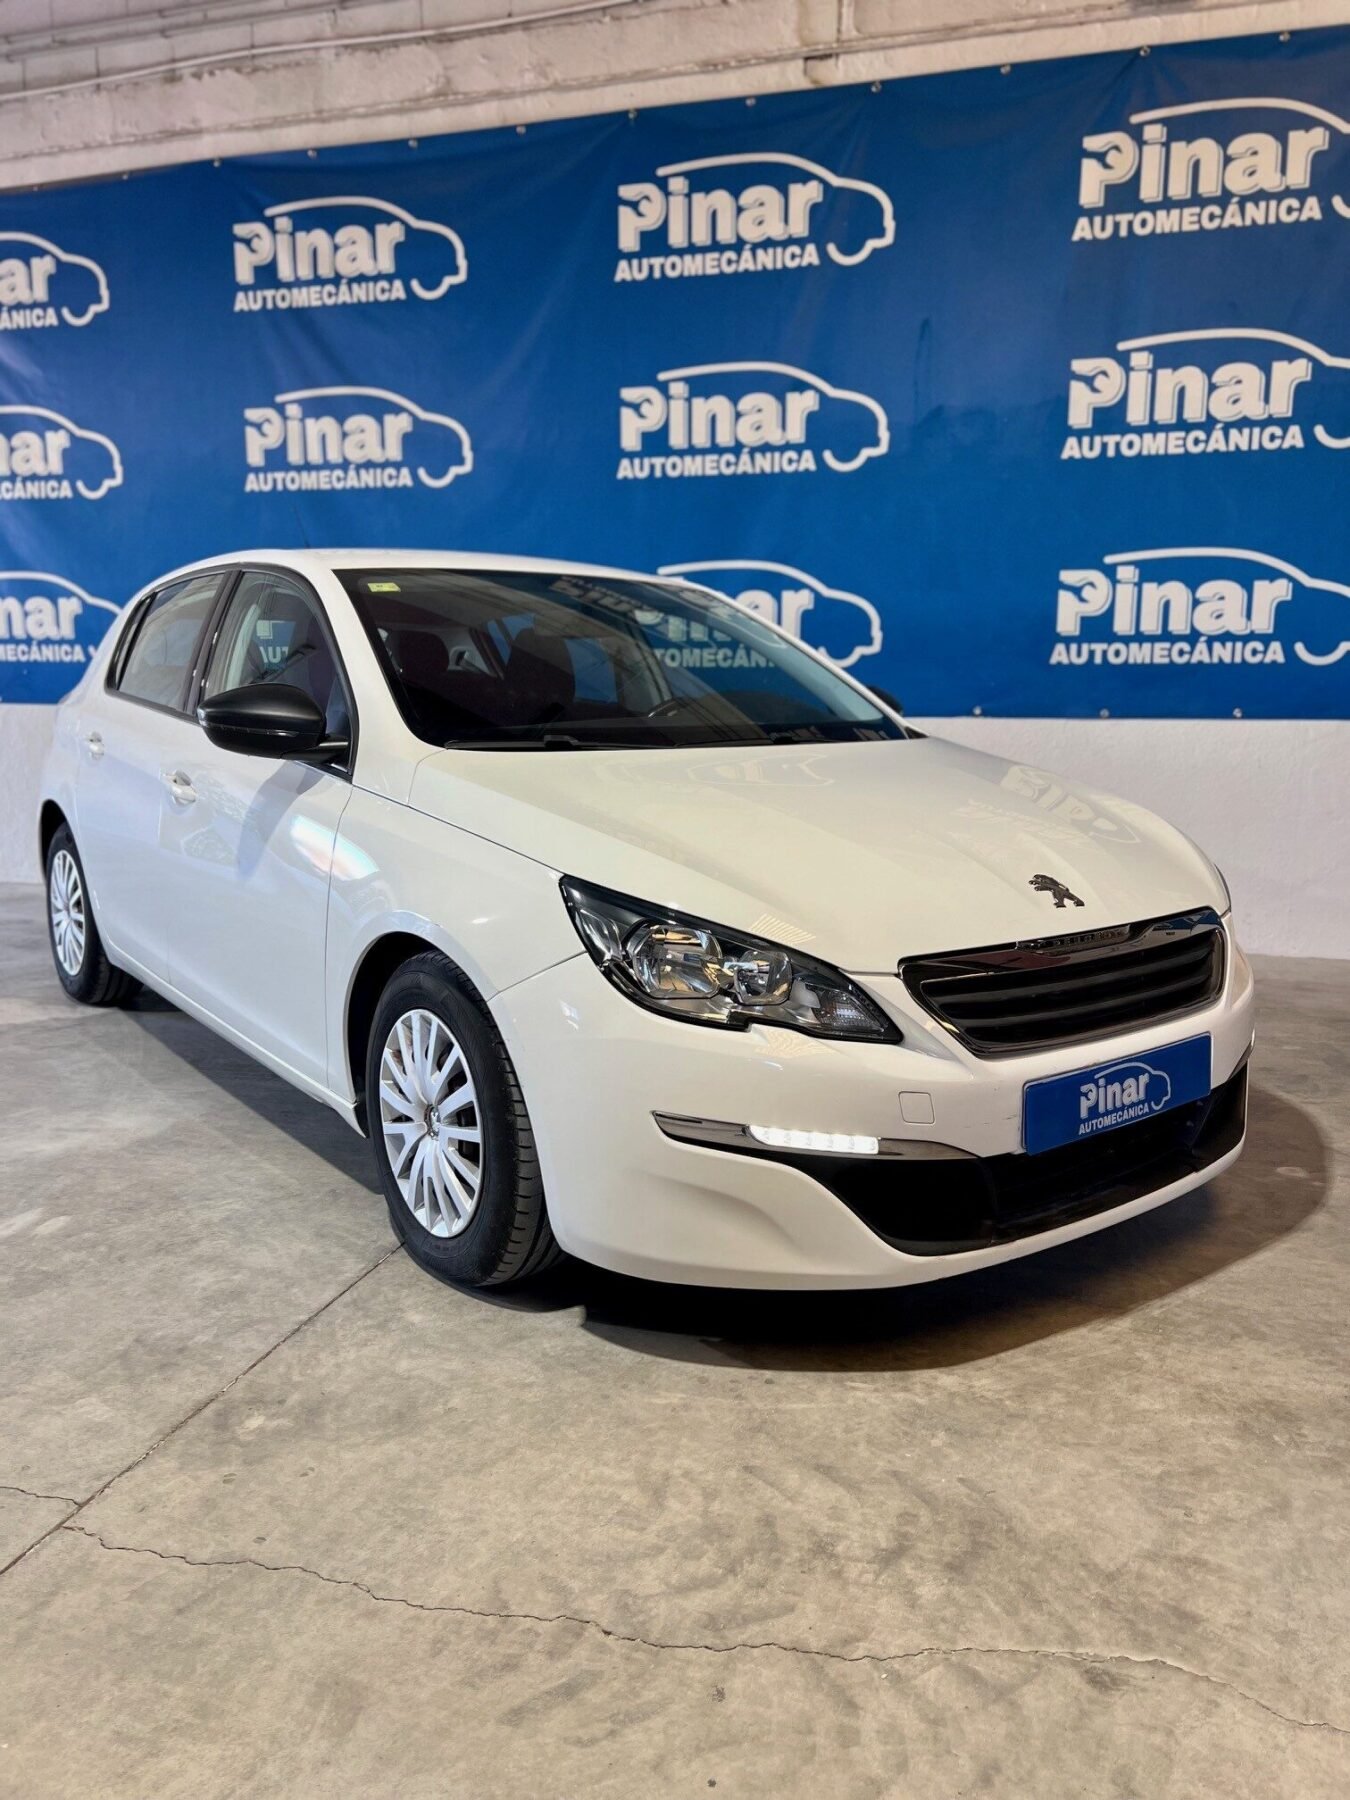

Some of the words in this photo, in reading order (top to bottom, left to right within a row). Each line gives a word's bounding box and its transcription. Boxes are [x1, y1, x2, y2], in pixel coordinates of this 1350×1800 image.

[1078, 123, 1330, 209] Pinar
[618, 176, 824, 253] Pinar
[1071, 196, 1323, 242] AUTOMECÁNICA
[233, 215, 406, 286] Pinar
[614, 243, 820, 283] AUTOMECÁNICA
[233, 279, 407, 313] AUTOMECÁNICA
[1067, 351, 1312, 429] Pinar
[244, 403, 413, 468] Pinar
[620, 380, 820, 452] Pinar
[616, 447, 817, 480] AUTOMECÁNICA
[1061, 423, 1304, 460] AUTOMECÁNICA
[244, 464, 413, 493] AUTOMECÁNICA
[1056, 565, 1293, 636] Pinar
[1049, 636, 1286, 665] AUTOMECÁNICA
[1078, 1102, 1150, 1136] AUTOMECÁNICA
[1080, 1072, 1150, 1120] Pinar
